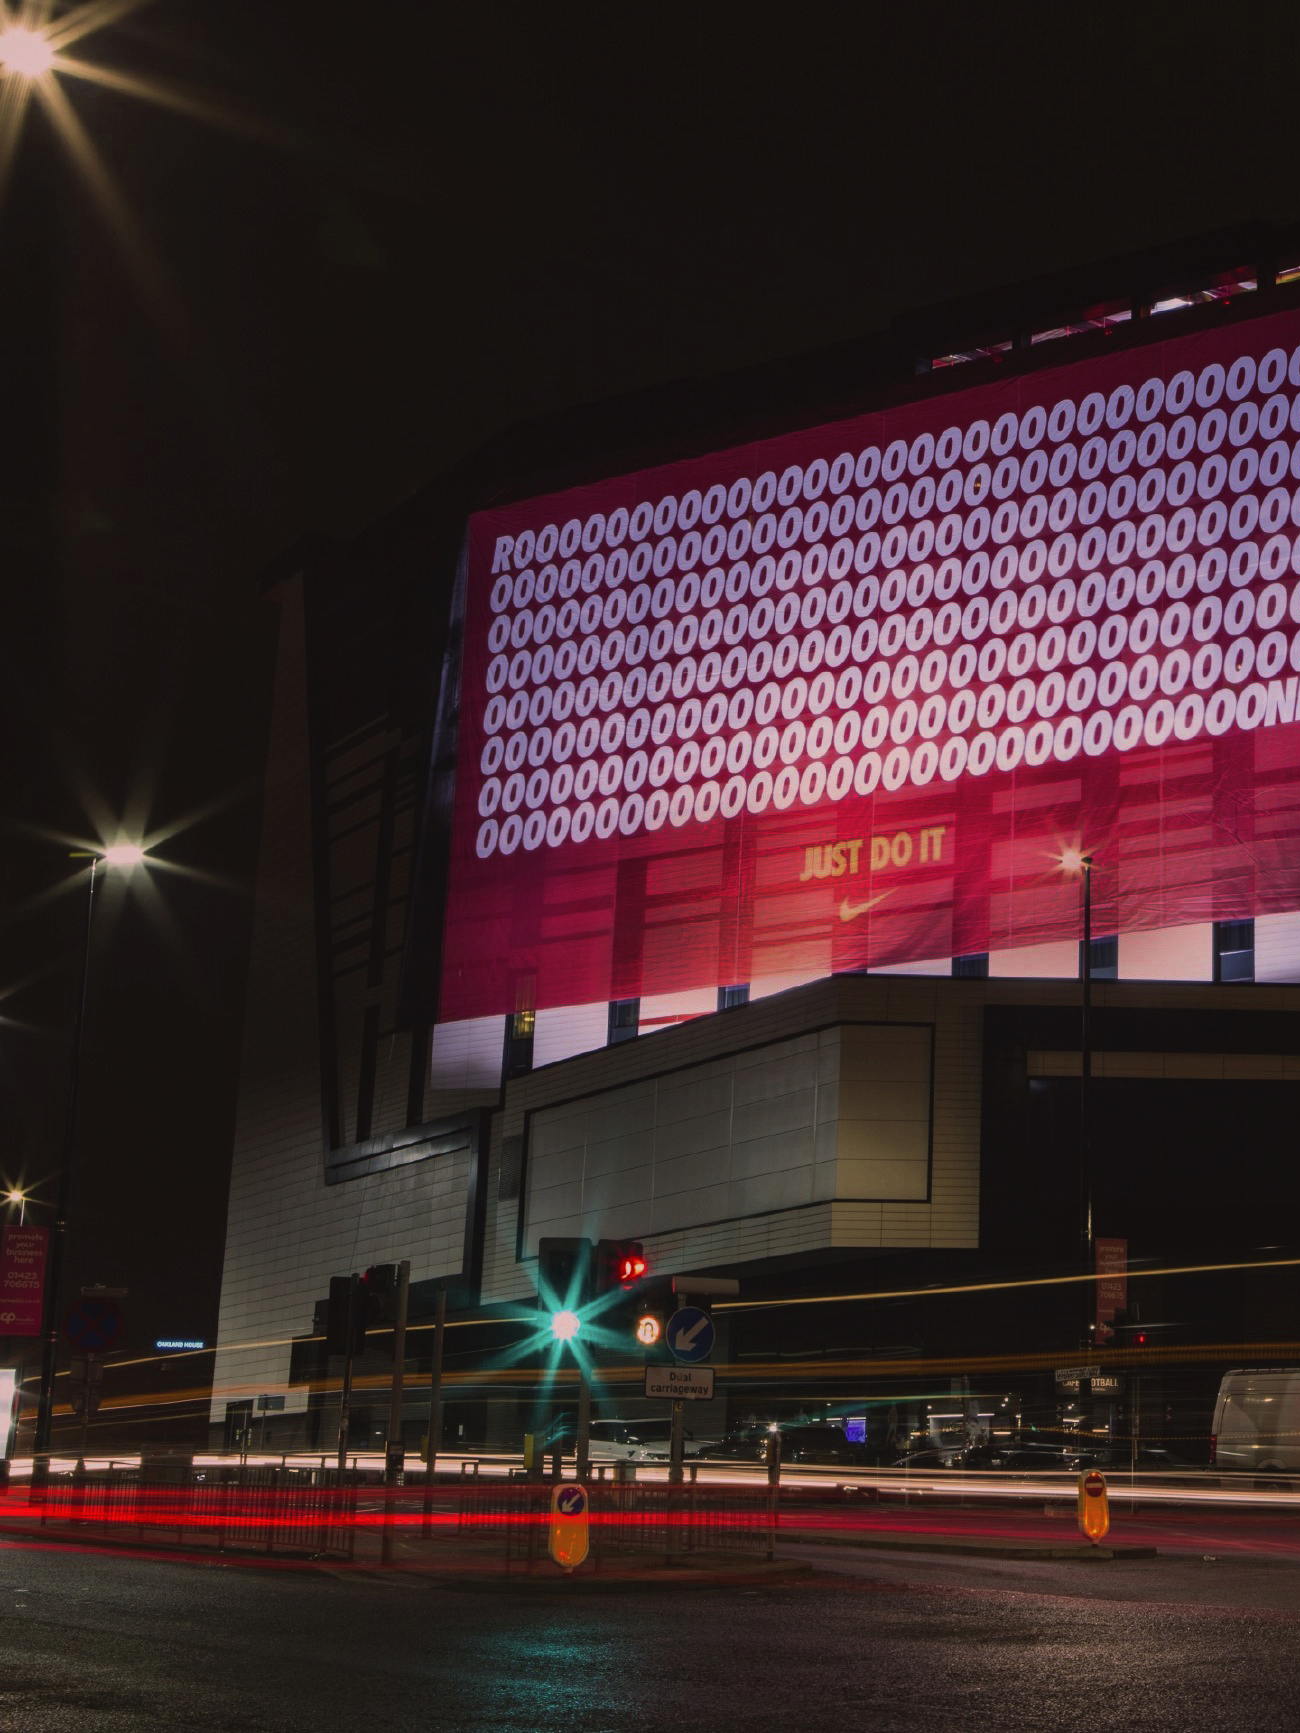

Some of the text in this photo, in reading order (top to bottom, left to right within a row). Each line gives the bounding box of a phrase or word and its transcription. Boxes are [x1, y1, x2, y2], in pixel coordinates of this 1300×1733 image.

[799, 826, 946, 881] JUST DO IT
[8, 1233, 44, 1242] promote
[6, 1247, 43, 1256] business
[14, 1256, 34, 1264] here
[7, 1271, 38, 1280] 01423
[670, 1372, 692, 1382] Dual
[650, 1383, 709, 1395] carriageway
